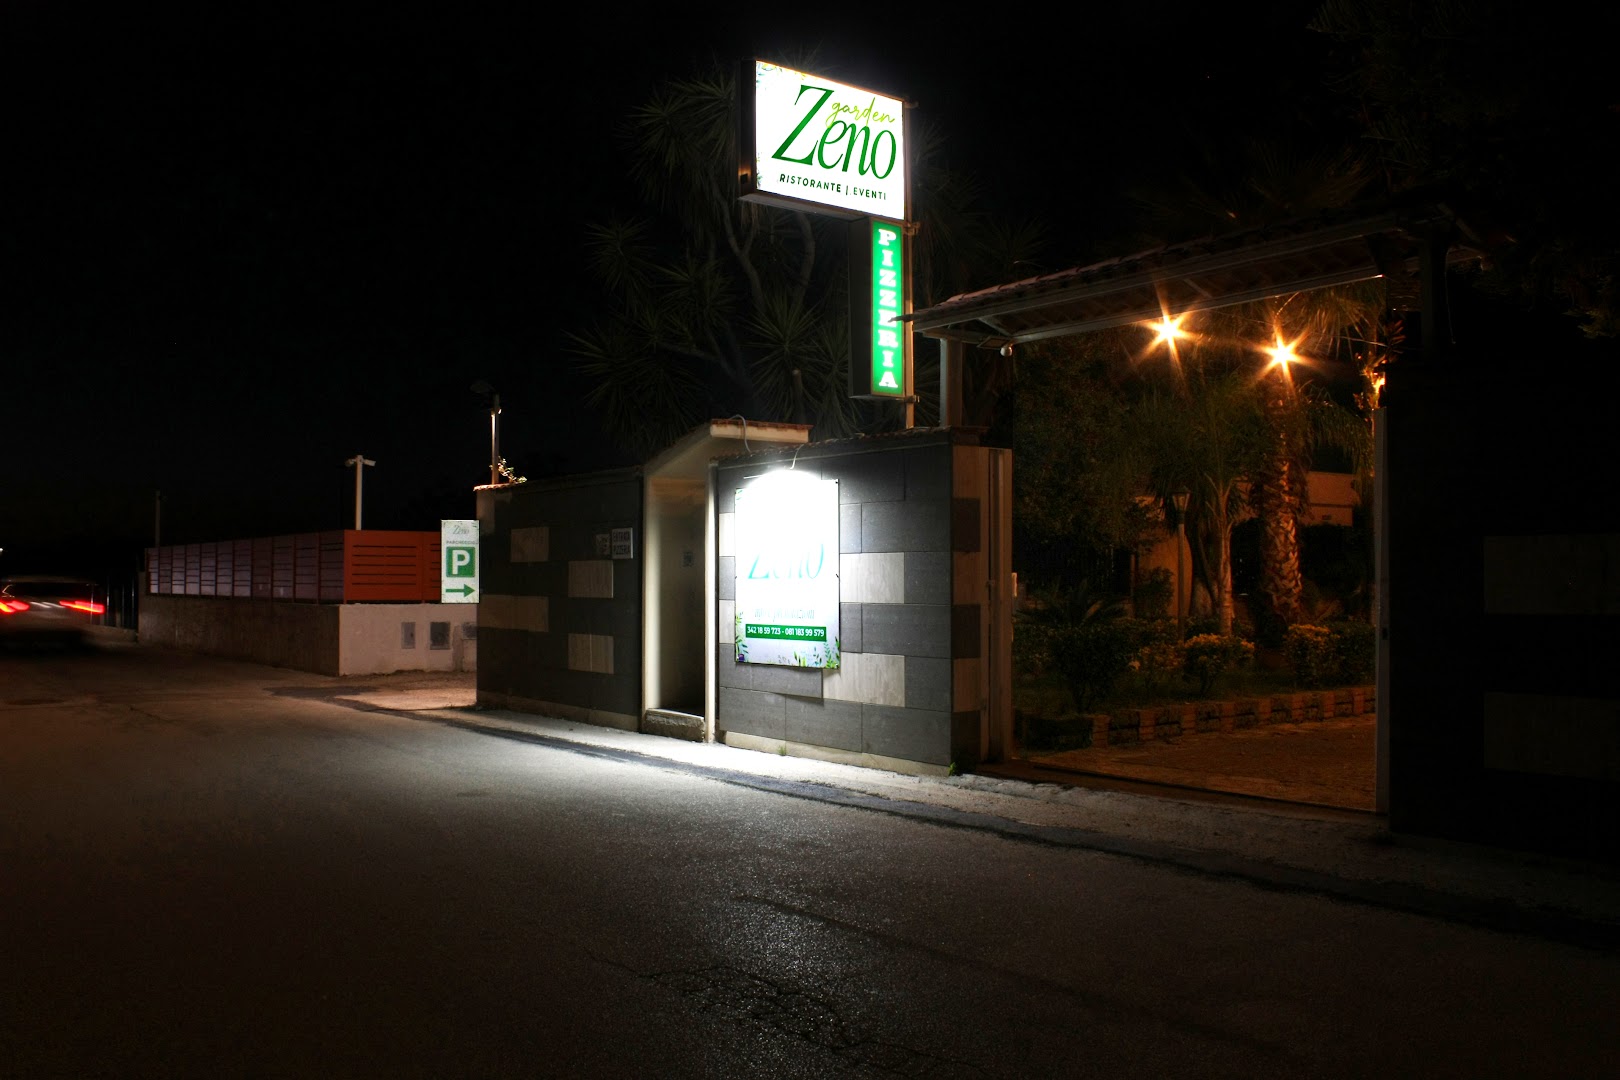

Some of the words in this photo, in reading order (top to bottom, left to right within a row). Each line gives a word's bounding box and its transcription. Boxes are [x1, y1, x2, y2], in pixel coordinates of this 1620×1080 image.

[825, 97, 896, 129] garden
[771, 84, 897, 180] Zeno
[779, 173, 842, 193] RISTORANTE
[853, 187, 887, 201] EVENTI
[877, 228, 899, 389] PIZZERIA
[452, 549, 471, 575] P
[747, 626, 757, 634] 342
[805, 628, 813, 637] 99
